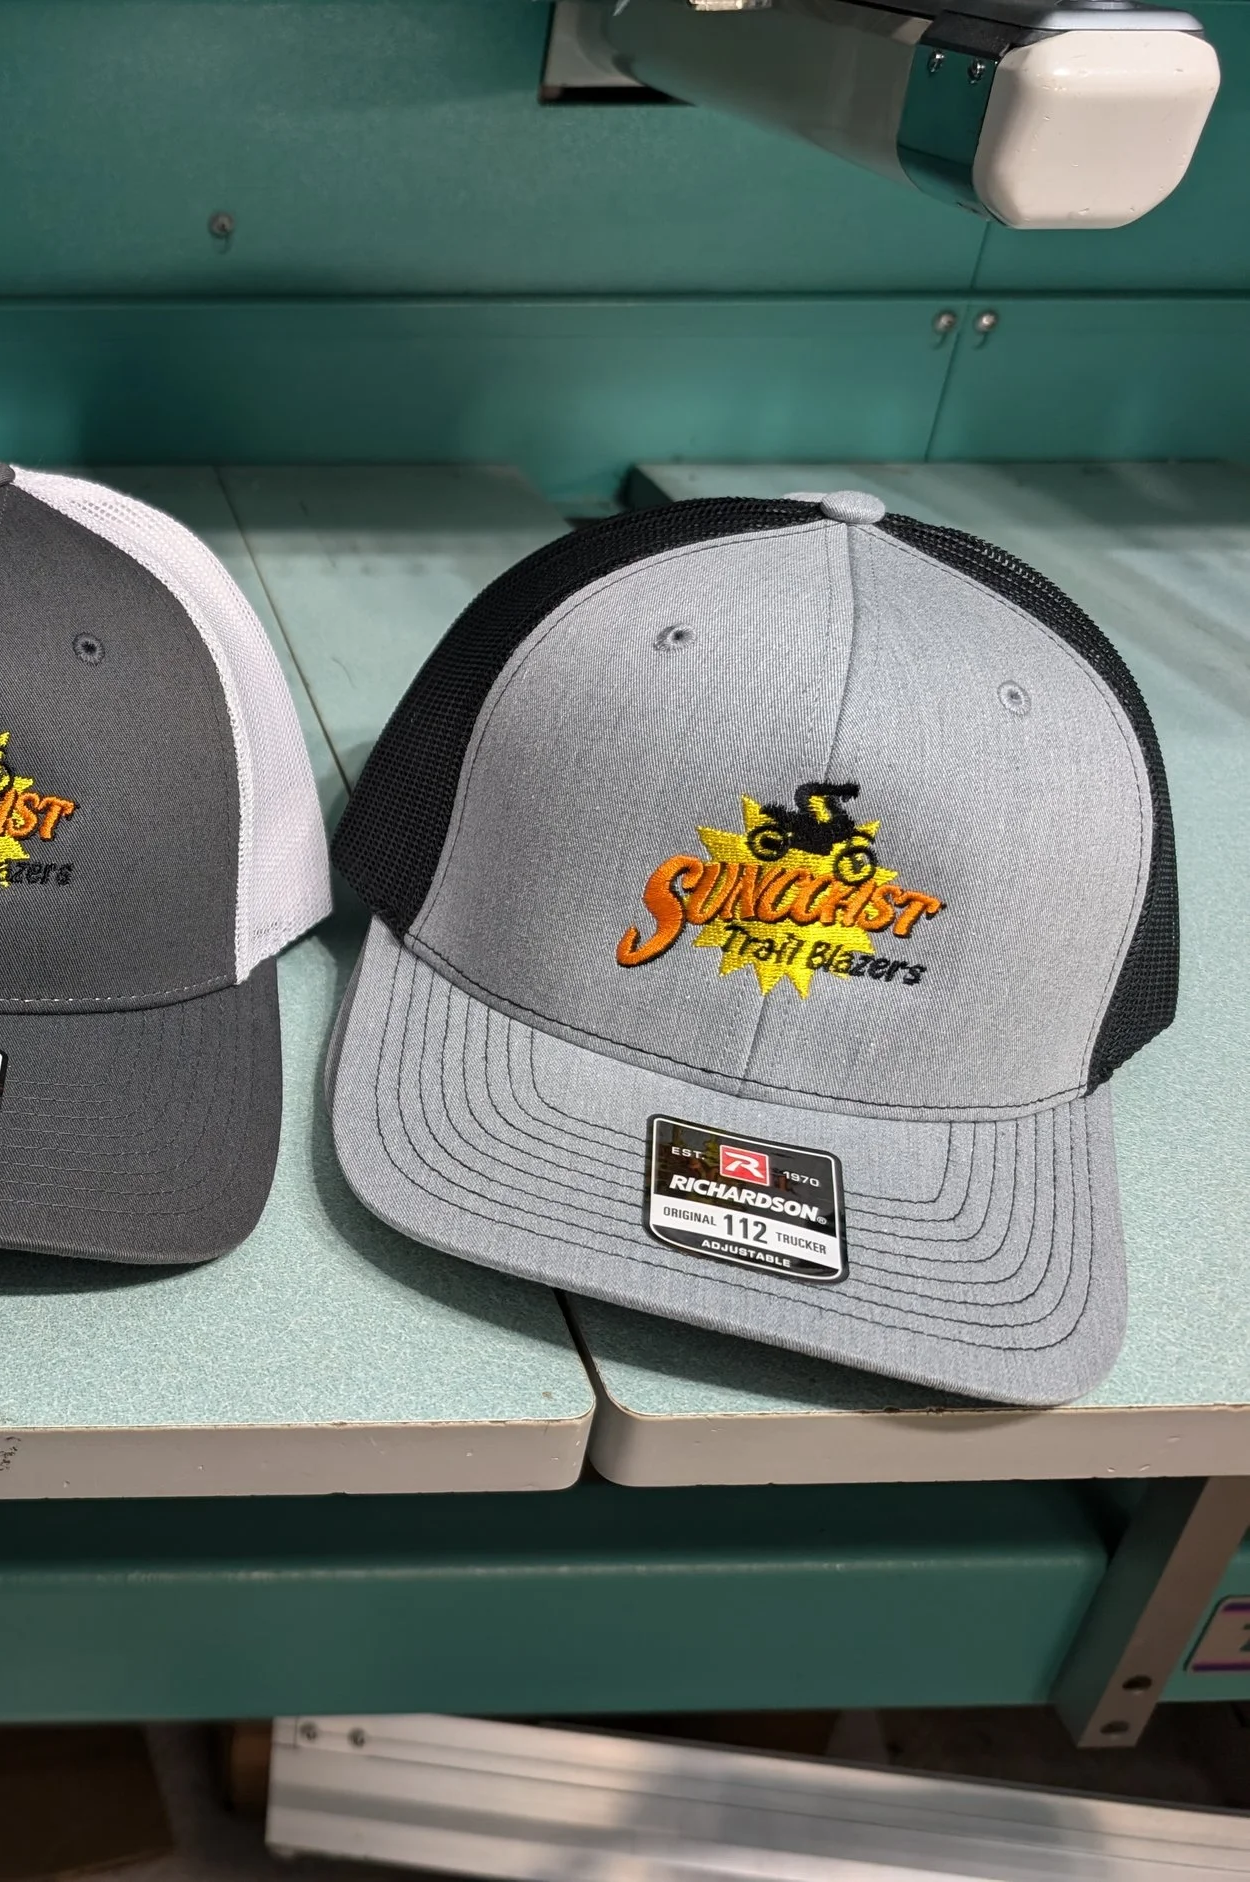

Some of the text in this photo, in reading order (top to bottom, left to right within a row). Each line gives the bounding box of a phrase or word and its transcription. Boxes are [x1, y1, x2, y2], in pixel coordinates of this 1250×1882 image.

[721, 923, 928, 986] Trail Blazers
[671, 1146, 706, 1161] EST.
[782, 1170, 820, 1188] 1970
[663, 1206, 827, 1255] ORIGINAL 112 TRUCKER
[701, 1239, 791, 1268] ADJUSTABLE
